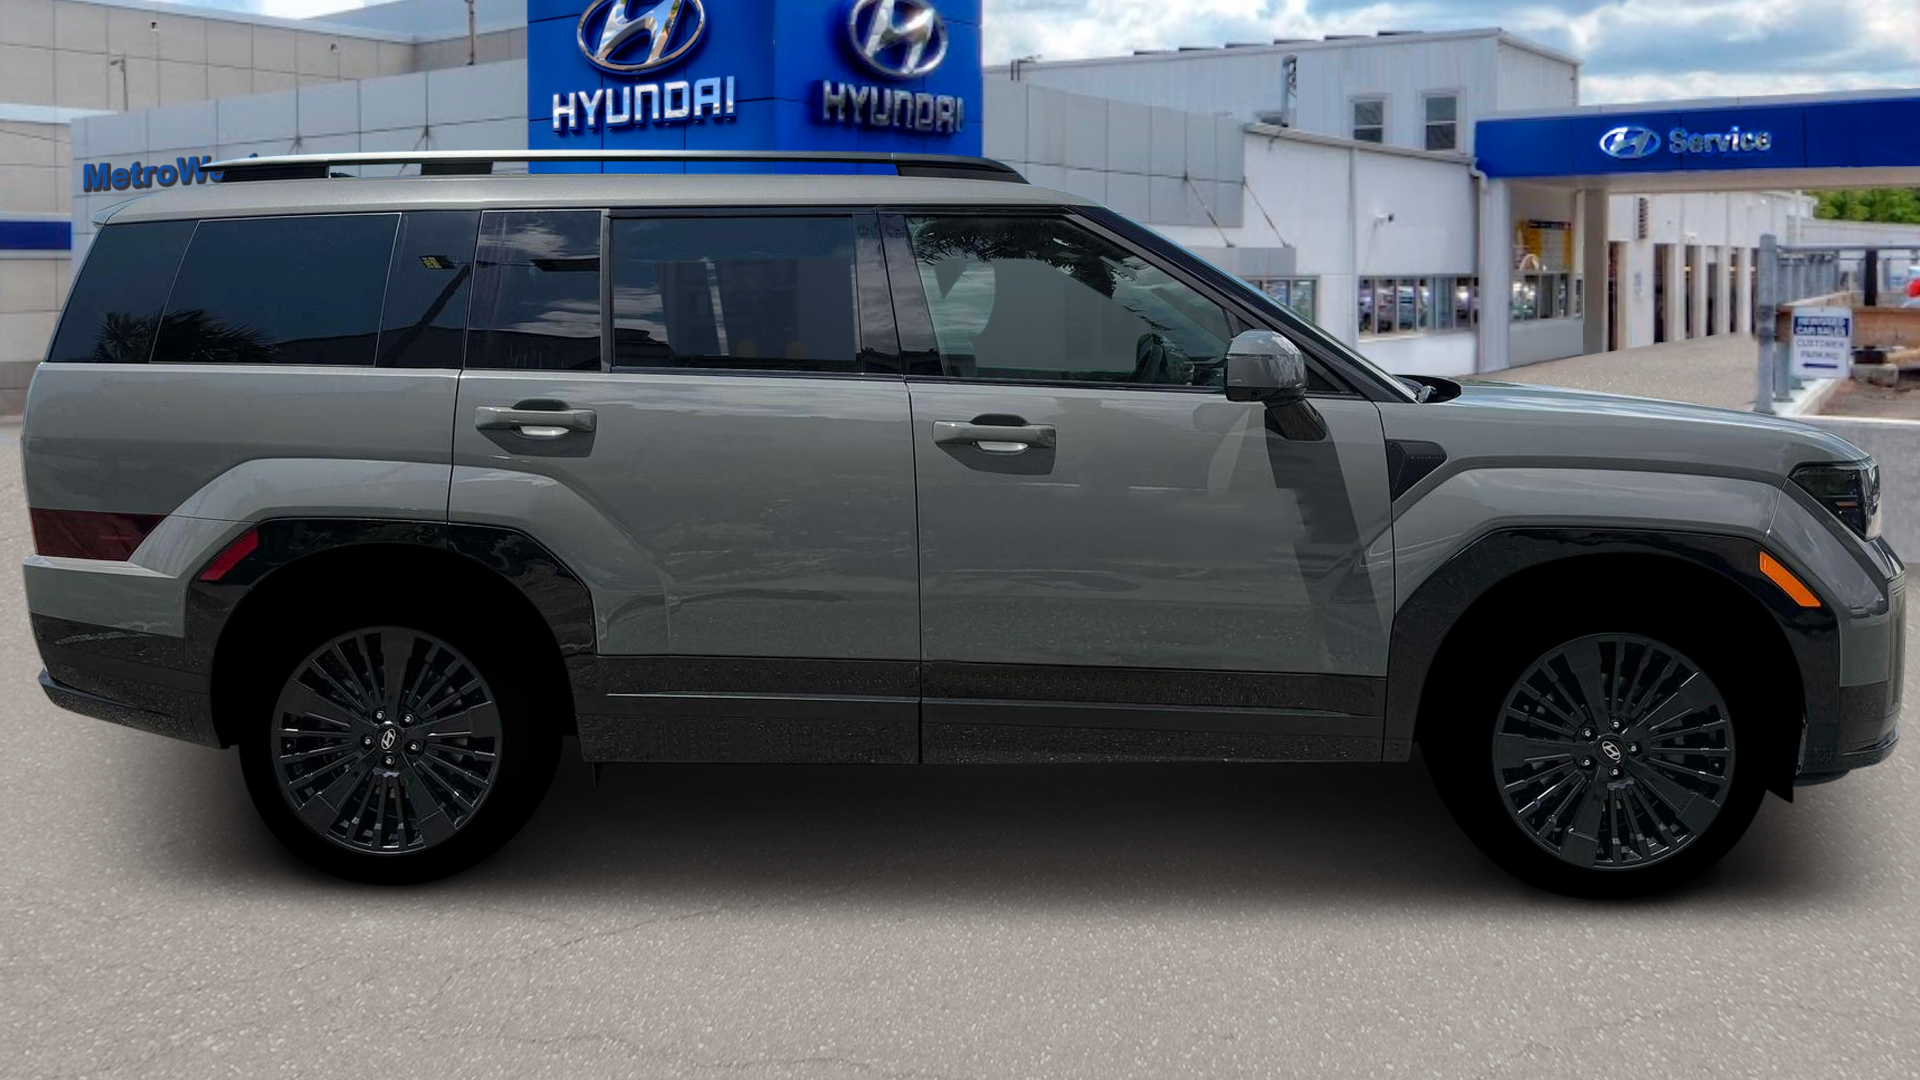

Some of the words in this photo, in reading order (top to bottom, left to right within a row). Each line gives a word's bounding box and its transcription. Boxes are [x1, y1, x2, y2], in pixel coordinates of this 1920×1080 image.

[552, 75, 737, 133] HYUNDAI
[821, 80, 965, 134] HYUNDAI
[1668, 125, 1772, 154] Service
[83, 153, 259, 192] MetroW
[1796, 339, 1844, 348] CUSTOMER
[1800, 350, 1839, 359] PARKING
